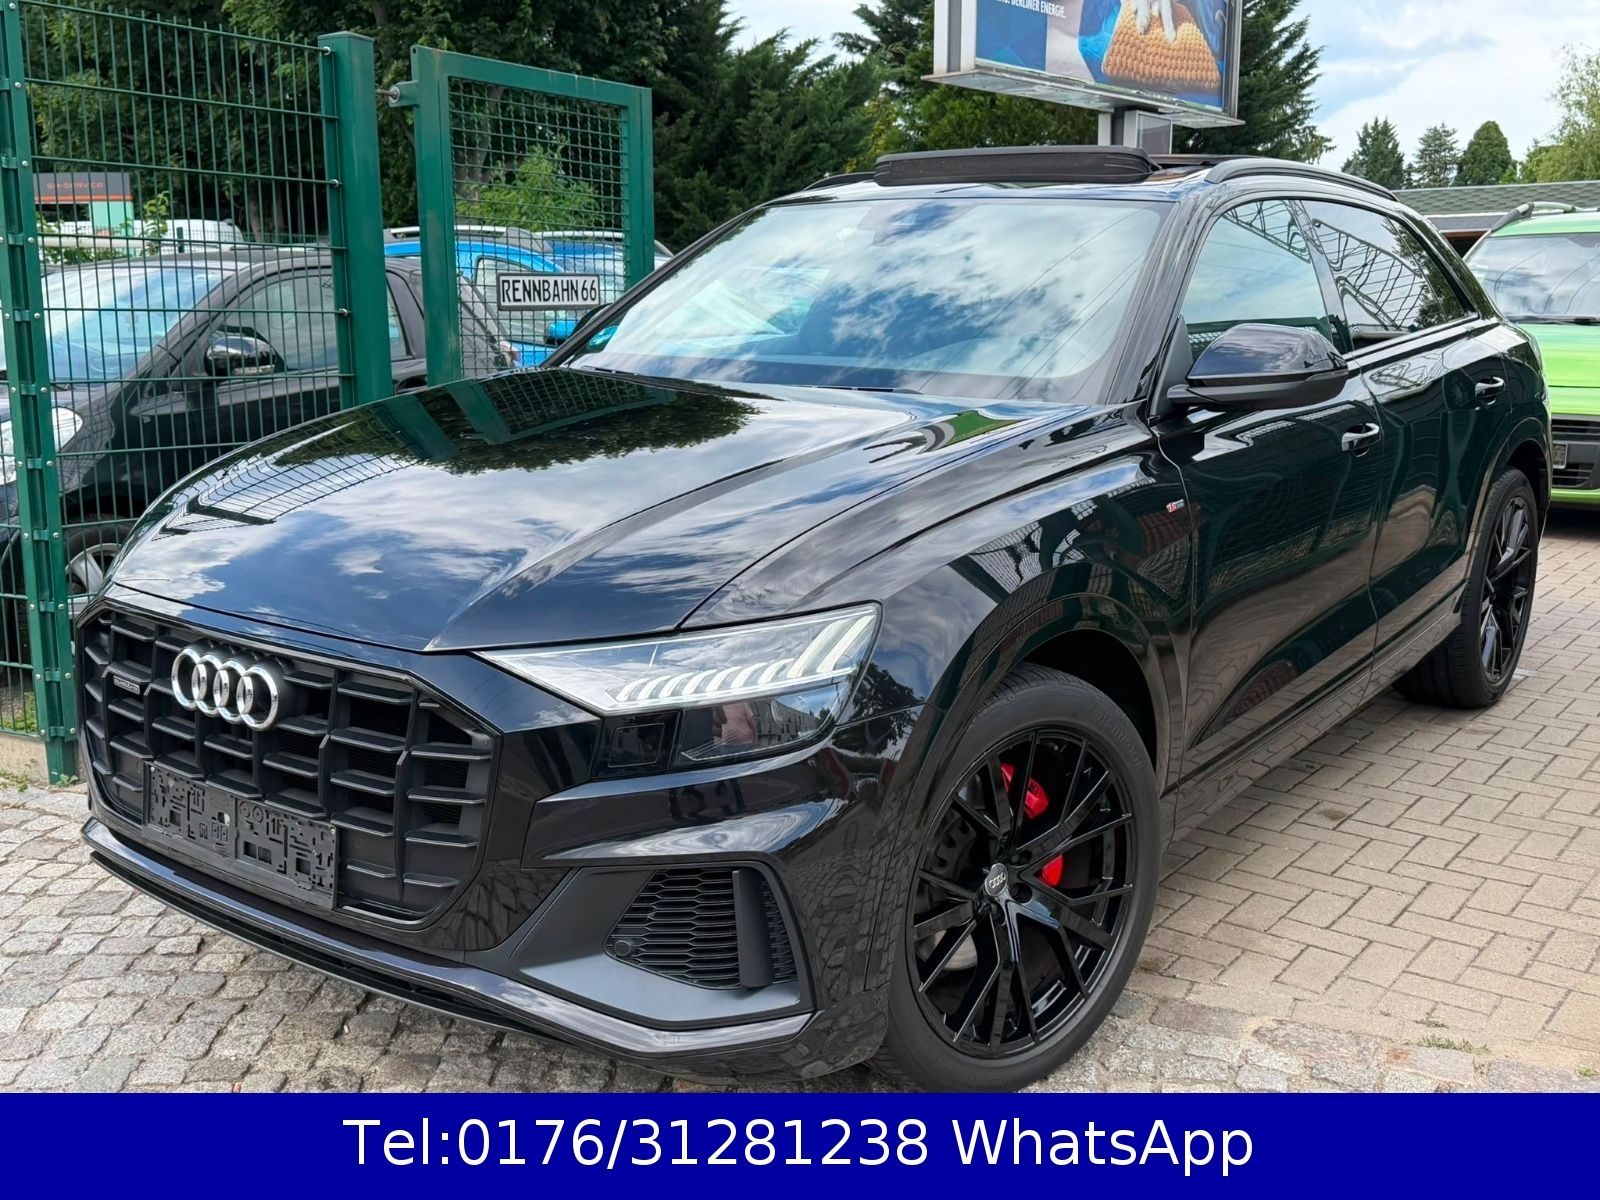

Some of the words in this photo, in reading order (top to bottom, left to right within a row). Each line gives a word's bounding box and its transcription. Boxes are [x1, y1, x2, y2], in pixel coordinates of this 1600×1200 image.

[1041, 1, 1067, 19] ENERGIE.
[501, 279, 579, 303] RENNBAHN
[581, 279, 597, 302] 66
